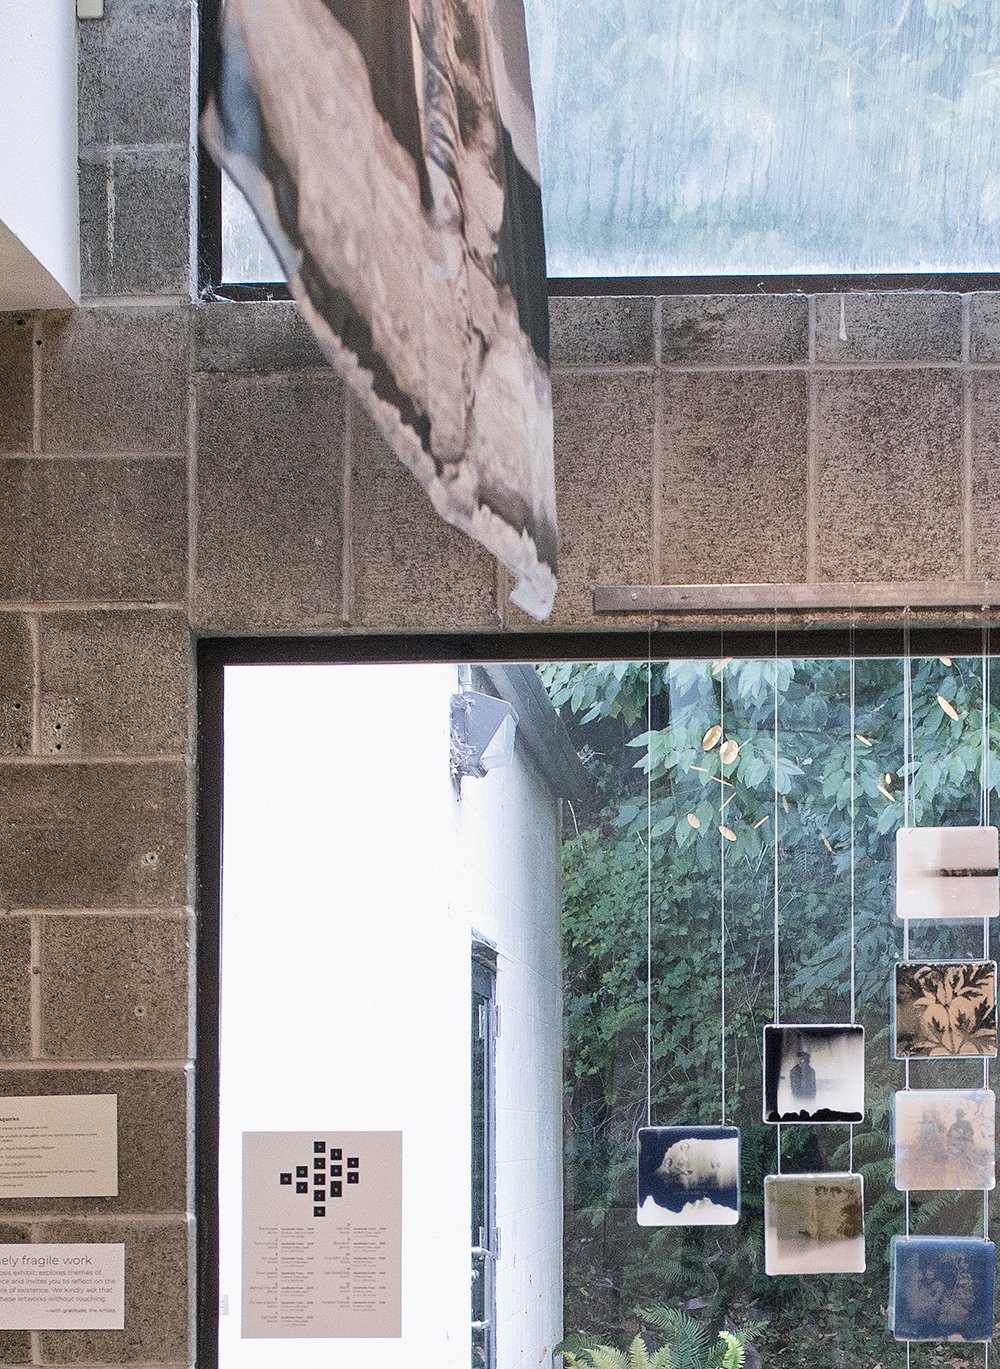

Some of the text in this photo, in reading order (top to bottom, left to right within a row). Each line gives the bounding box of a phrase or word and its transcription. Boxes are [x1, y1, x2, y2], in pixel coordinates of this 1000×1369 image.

[0, 1254, 93, 1268] ely fragile work
[38, 1269, 66, 1277] explores
[64, 1287, 85, 1295] kindly
